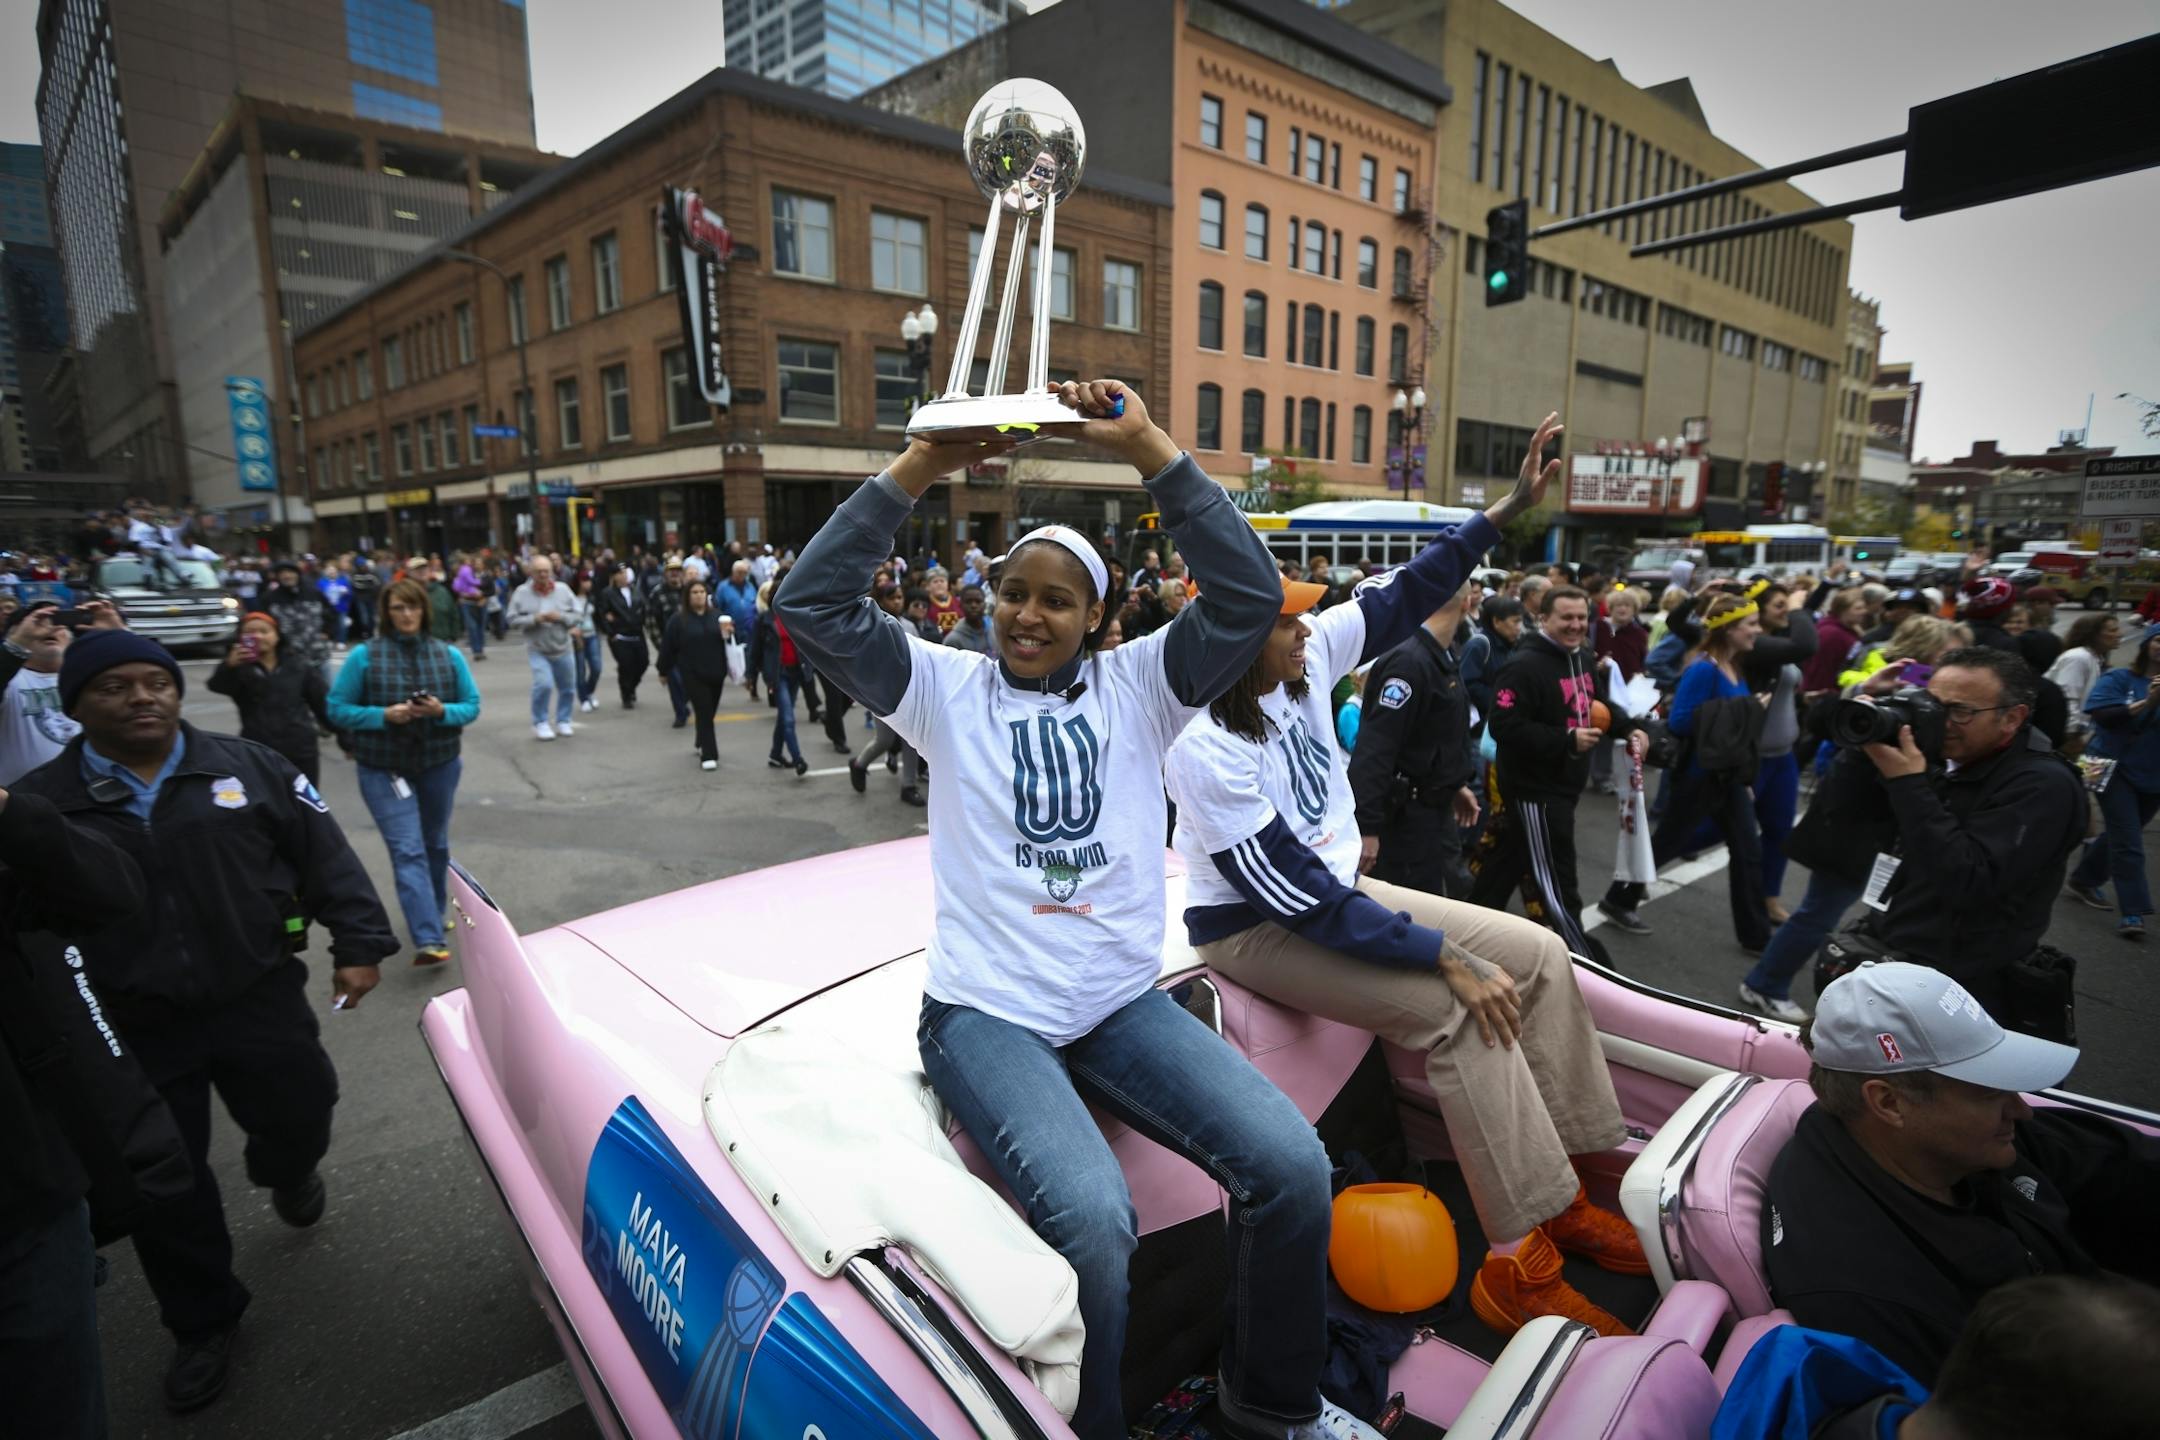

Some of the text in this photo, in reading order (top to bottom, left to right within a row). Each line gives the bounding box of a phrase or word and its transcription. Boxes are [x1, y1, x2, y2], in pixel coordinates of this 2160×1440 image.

[2103, 461, 2140, 472] RIGHT
[2089, 479, 2136, 489] BUSES
[2097, 490, 2131, 501] RIGHT
[2114, 521, 2132, 534] NO
[1015, 841, 1108, 868] IS FOR WIN
[73, 971, 122, 1058] Manfrotto
[627, 1191, 687, 1301] MAYA
[616, 1228, 685, 1366] MOORE
